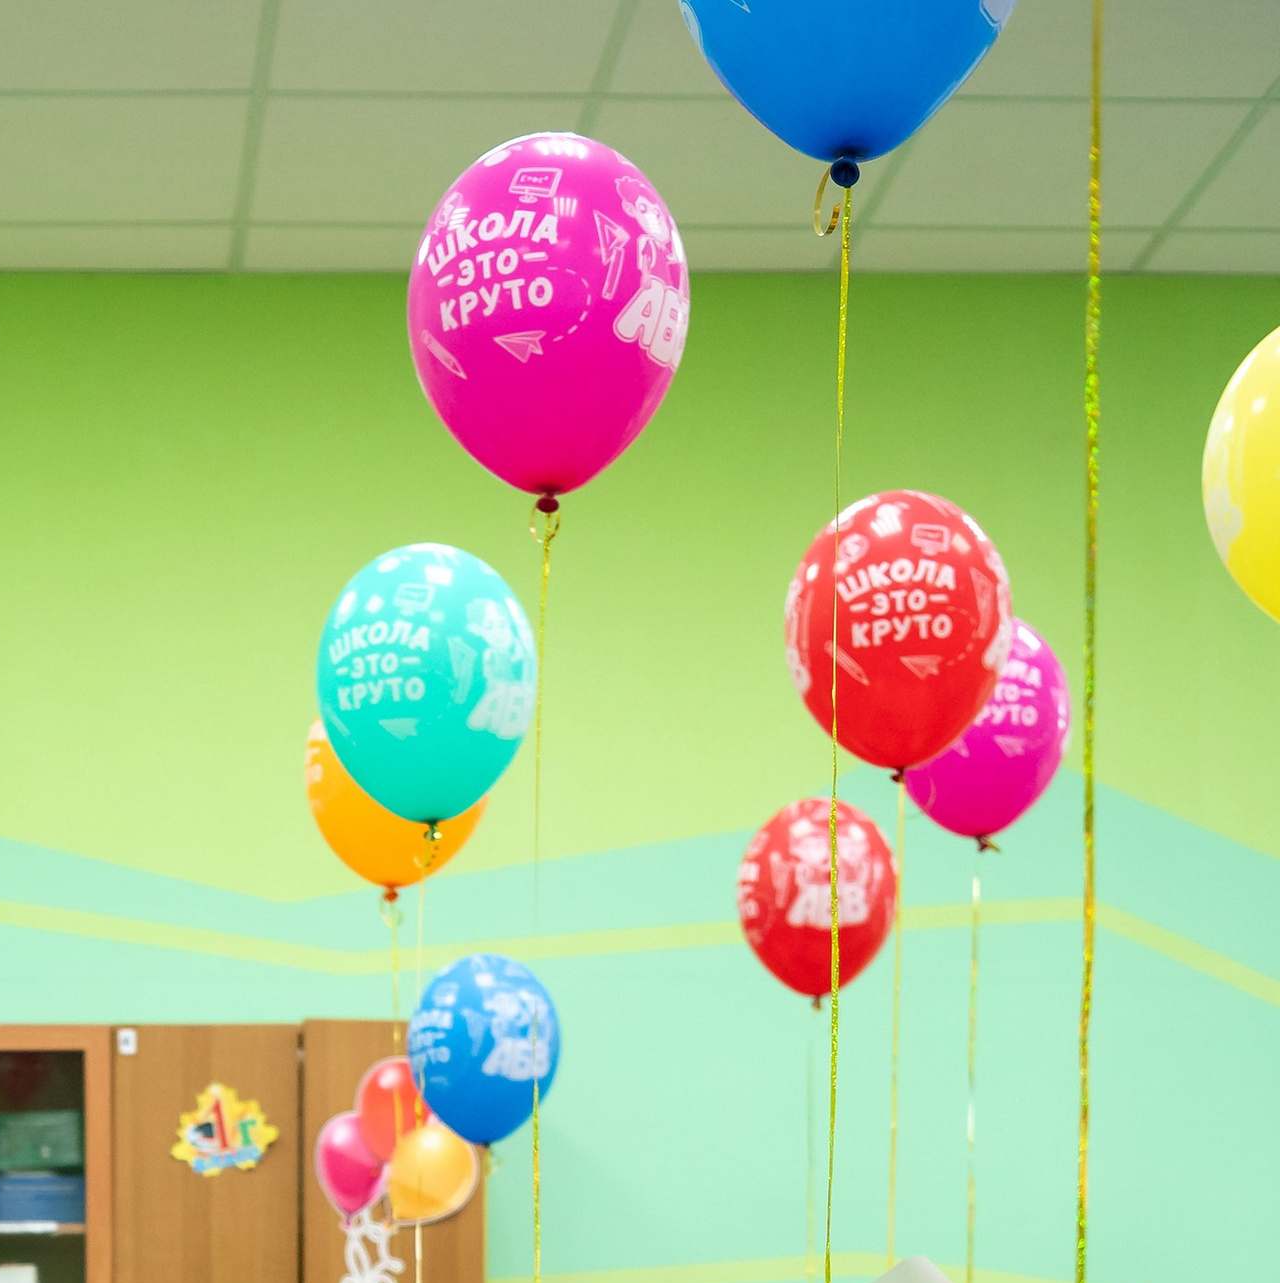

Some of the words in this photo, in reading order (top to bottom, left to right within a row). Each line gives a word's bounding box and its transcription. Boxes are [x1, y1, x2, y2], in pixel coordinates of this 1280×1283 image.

[426, 210, 558, 276] ШКОЛА
[439, 277, 553, 332] КРУТО
[836, 558, 956, 601] ШКОЛА
[329, 619, 430, 666] ШКОЛА
[851, 613, 953, 648] КРУТО
[338, 676, 426, 711] КРУТО
[466, 678, 538, 741] АБ
